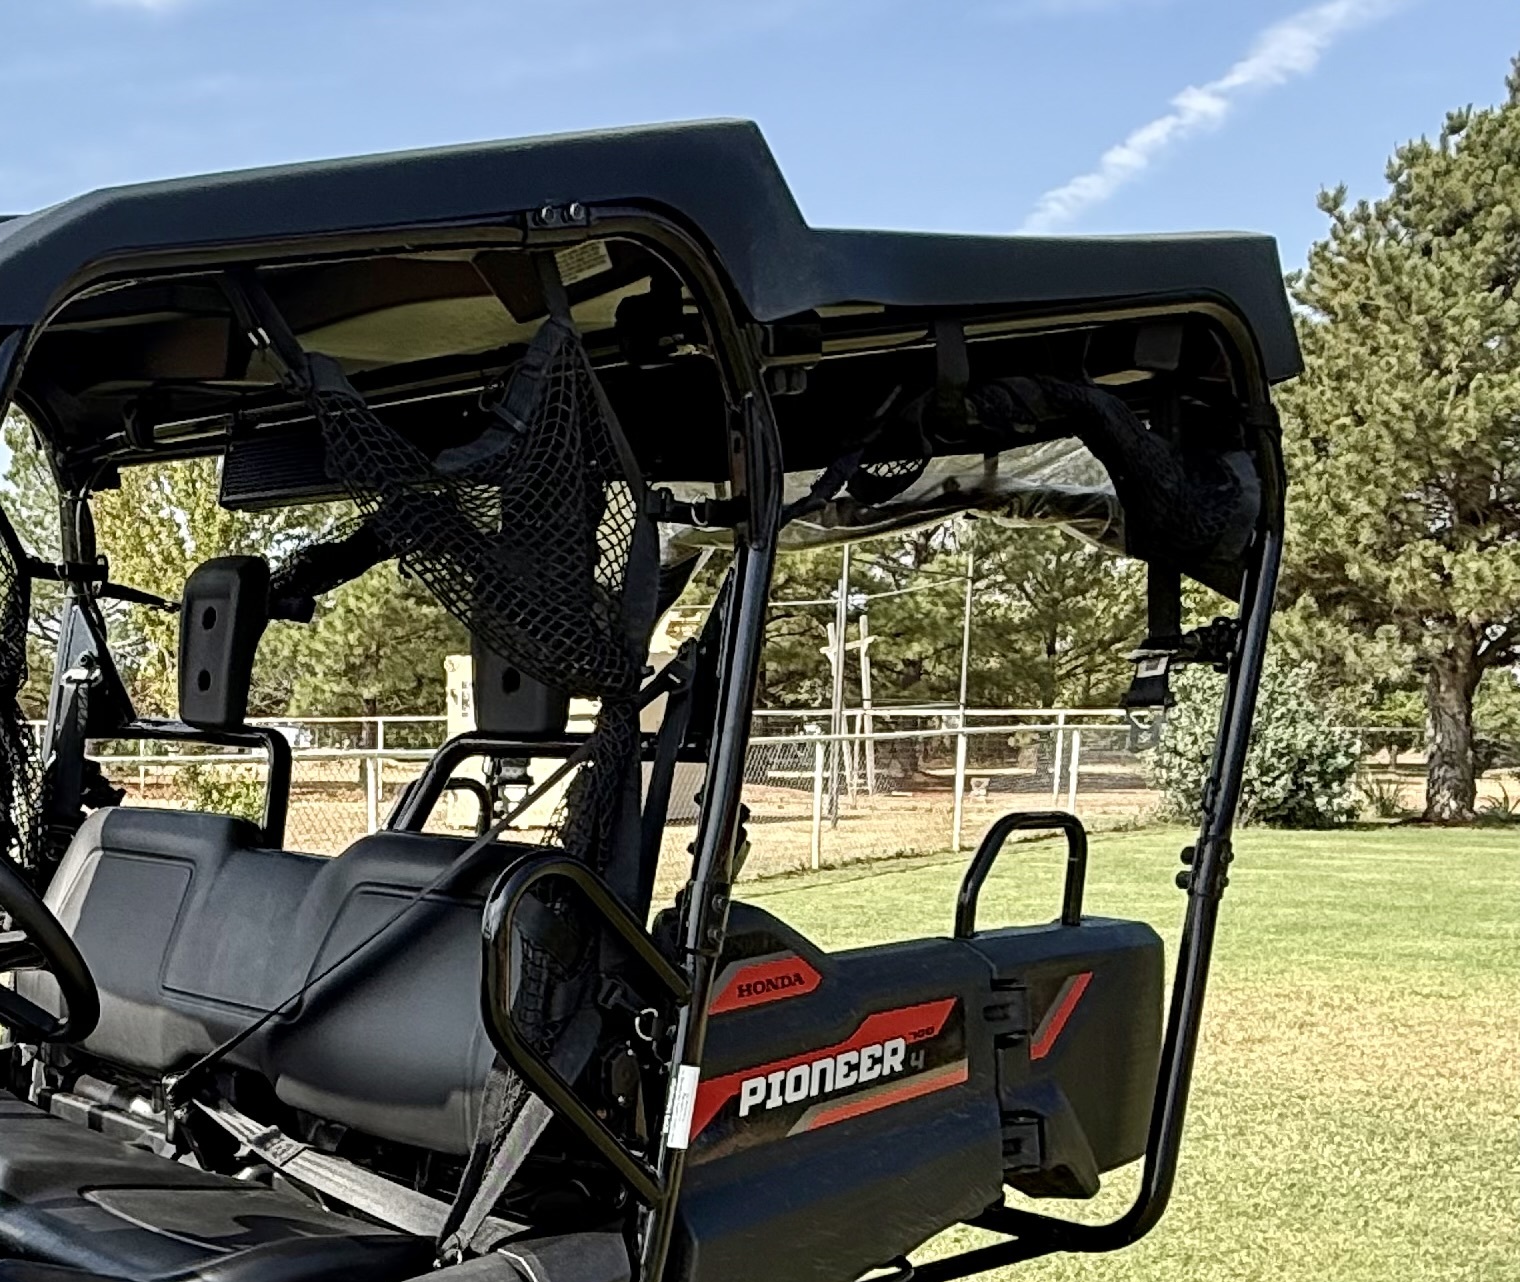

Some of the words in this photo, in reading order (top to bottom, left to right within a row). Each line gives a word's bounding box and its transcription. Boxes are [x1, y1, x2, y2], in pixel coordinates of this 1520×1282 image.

[737, 972, 805, 998] HONDA
[738, 1037, 906, 1118] PIONEER
[910, 1049, 925, 1070] 4
